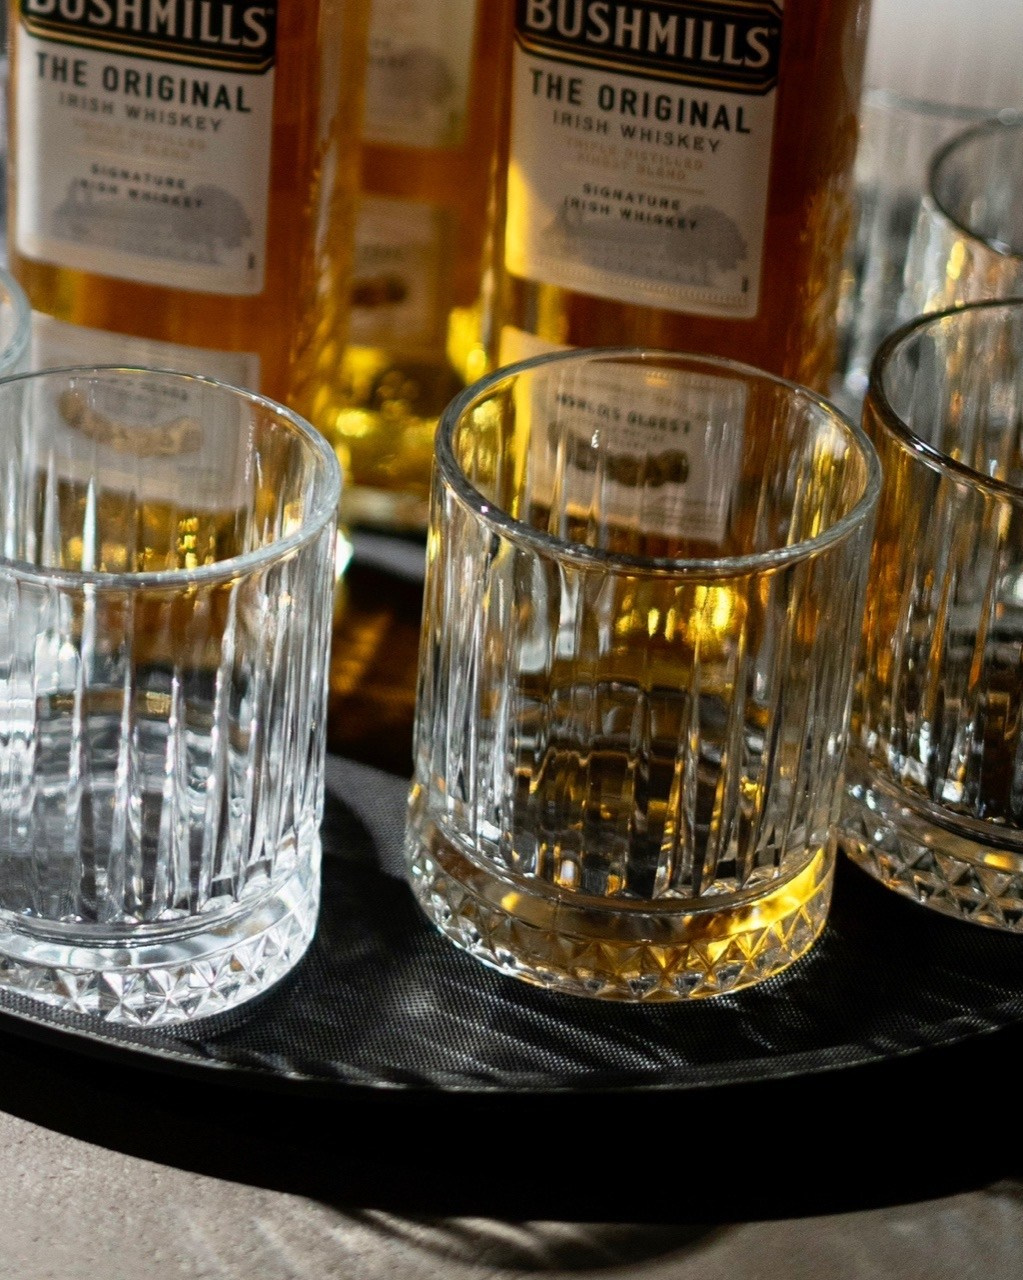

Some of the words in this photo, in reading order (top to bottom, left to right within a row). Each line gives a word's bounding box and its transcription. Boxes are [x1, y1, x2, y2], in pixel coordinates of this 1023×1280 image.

[37, 51, 88, 88] THE
[102, 65, 252, 113] ORIGINAL
[530, 69, 583, 106] THE
[597, 83, 752, 134] ORIGINAL
[58, 90, 115, 116] IRISH
[124, 104, 223, 133] WHISKEY
[552, 109, 609, 135] IRISH
[620, 123, 721, 153] WHISKEY
[89, 163, 187, 190] SIGNATURE
[582, 182, 681, 211] SIGNATURE
[128, 188, 204, 209] WHISKEY
[562, 194, 610, 215] IRISH
[619, 207, 698, 231] WHISKEY
